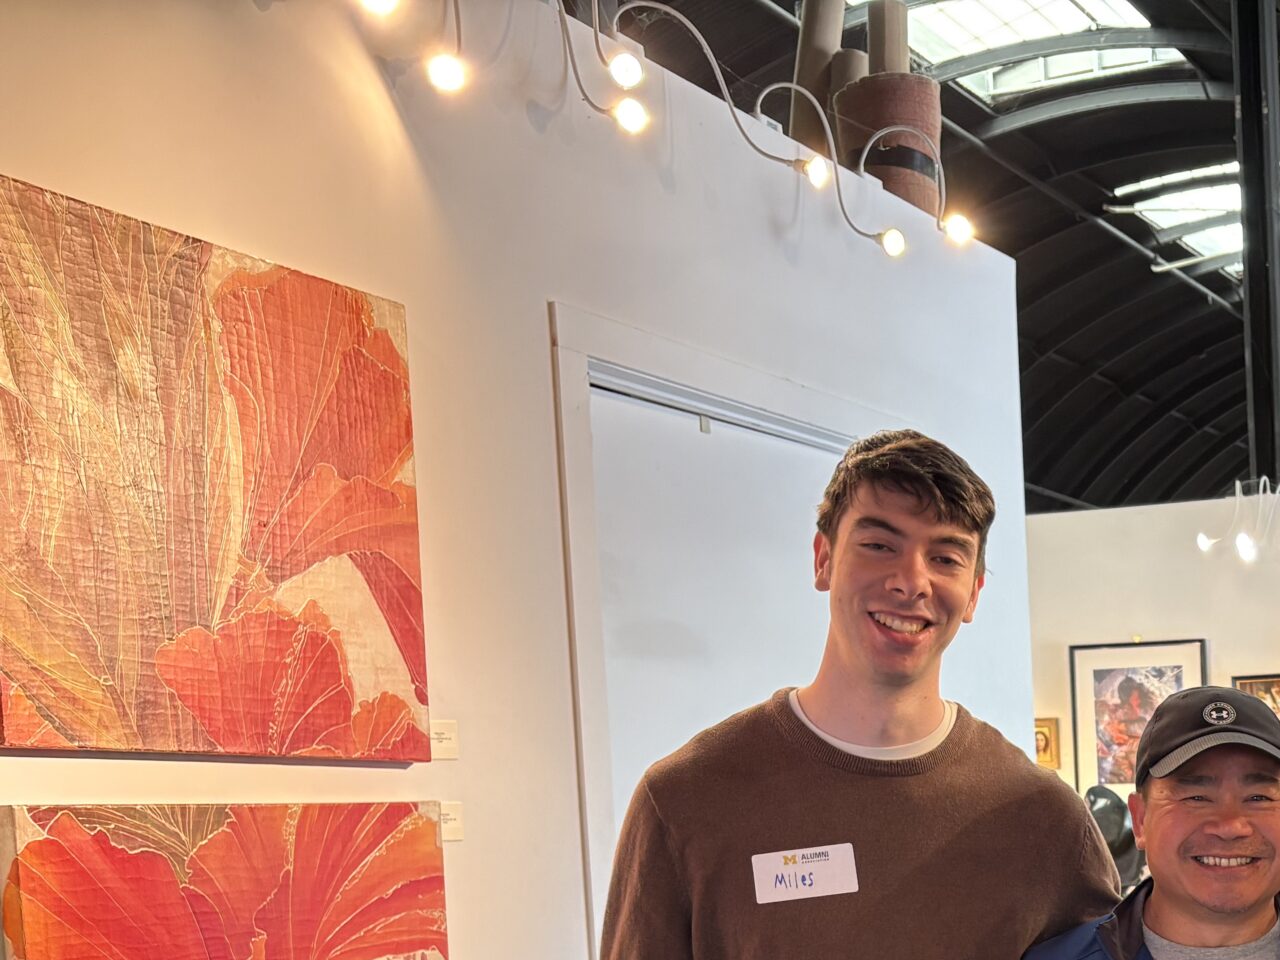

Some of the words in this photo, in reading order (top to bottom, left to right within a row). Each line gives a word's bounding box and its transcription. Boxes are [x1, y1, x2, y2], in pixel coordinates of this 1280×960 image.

[783, 854, 798, 866] M
[801, 851, 830, 860] ALUMNI
[774, 871, 814, 889] Miles
